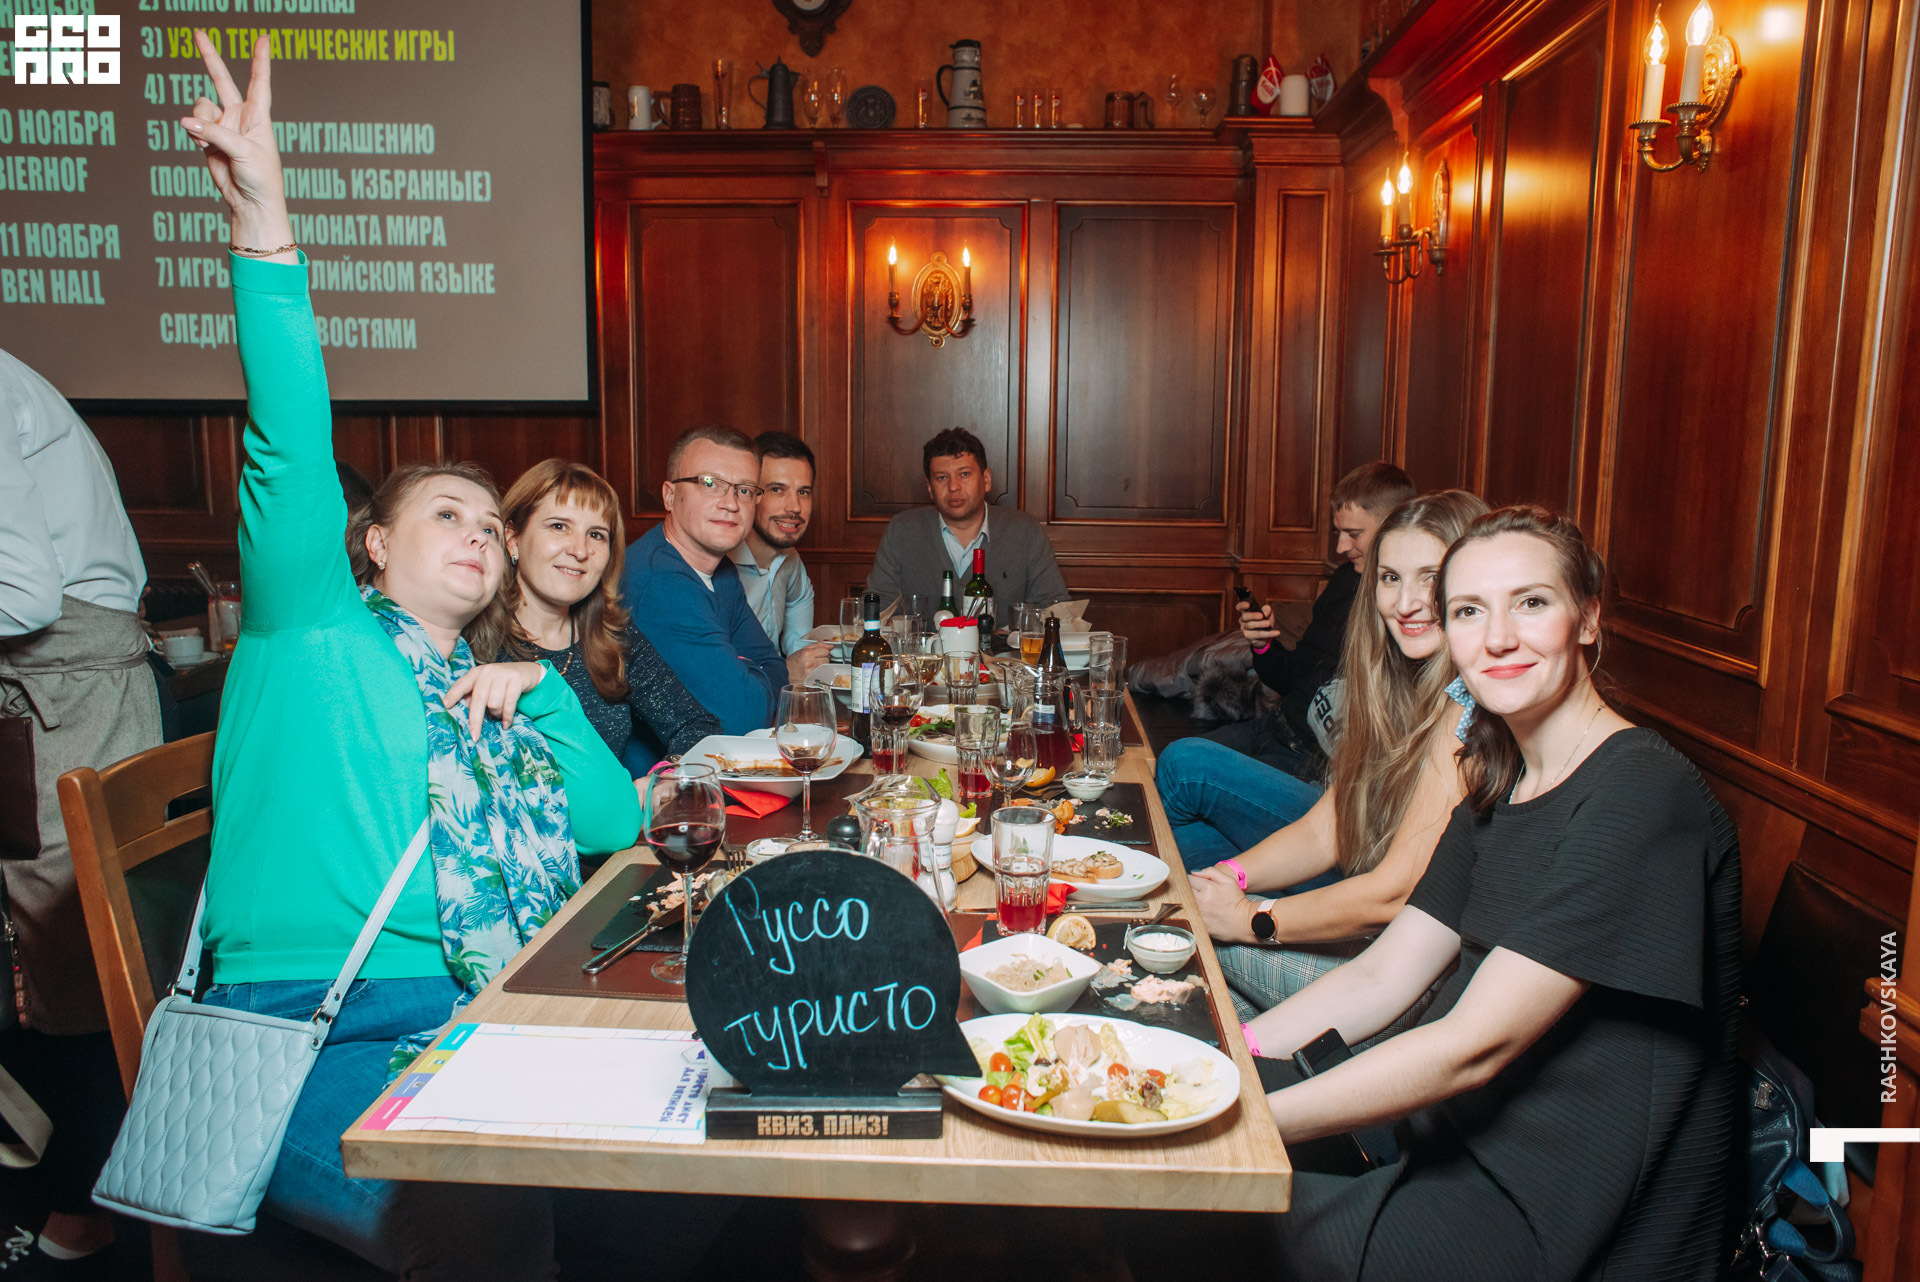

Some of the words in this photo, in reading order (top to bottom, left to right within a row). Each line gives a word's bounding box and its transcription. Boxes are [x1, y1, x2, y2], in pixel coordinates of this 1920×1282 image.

[141, 26, 163, 58] 3)
[394, 29, 455, 61] ИГРЫ
[144, 73, 165, 105] 4)
[18, 109, 116, 146] НОЯБРЯ
[147, 120, 169, 151] 5)
[351, 168, 492, 202] ИЗБРАННЫЕ)
[24, 222, 120, 259] НОЯБРЯ
[153, 211, 175, 242] 6)
[386, 215, 447, 247] МИРА
[1, 268, 46, 304] BEN
[50, 269, 105, 305] HALL
[155, 257, 175, 287] 7)
[420, 261, 496, 294] ЯЗЫКЕ
[757, 1115, 819, 1137] КВИЗ,
[823, 1114, 889, 1136] ПЛИЗ!
